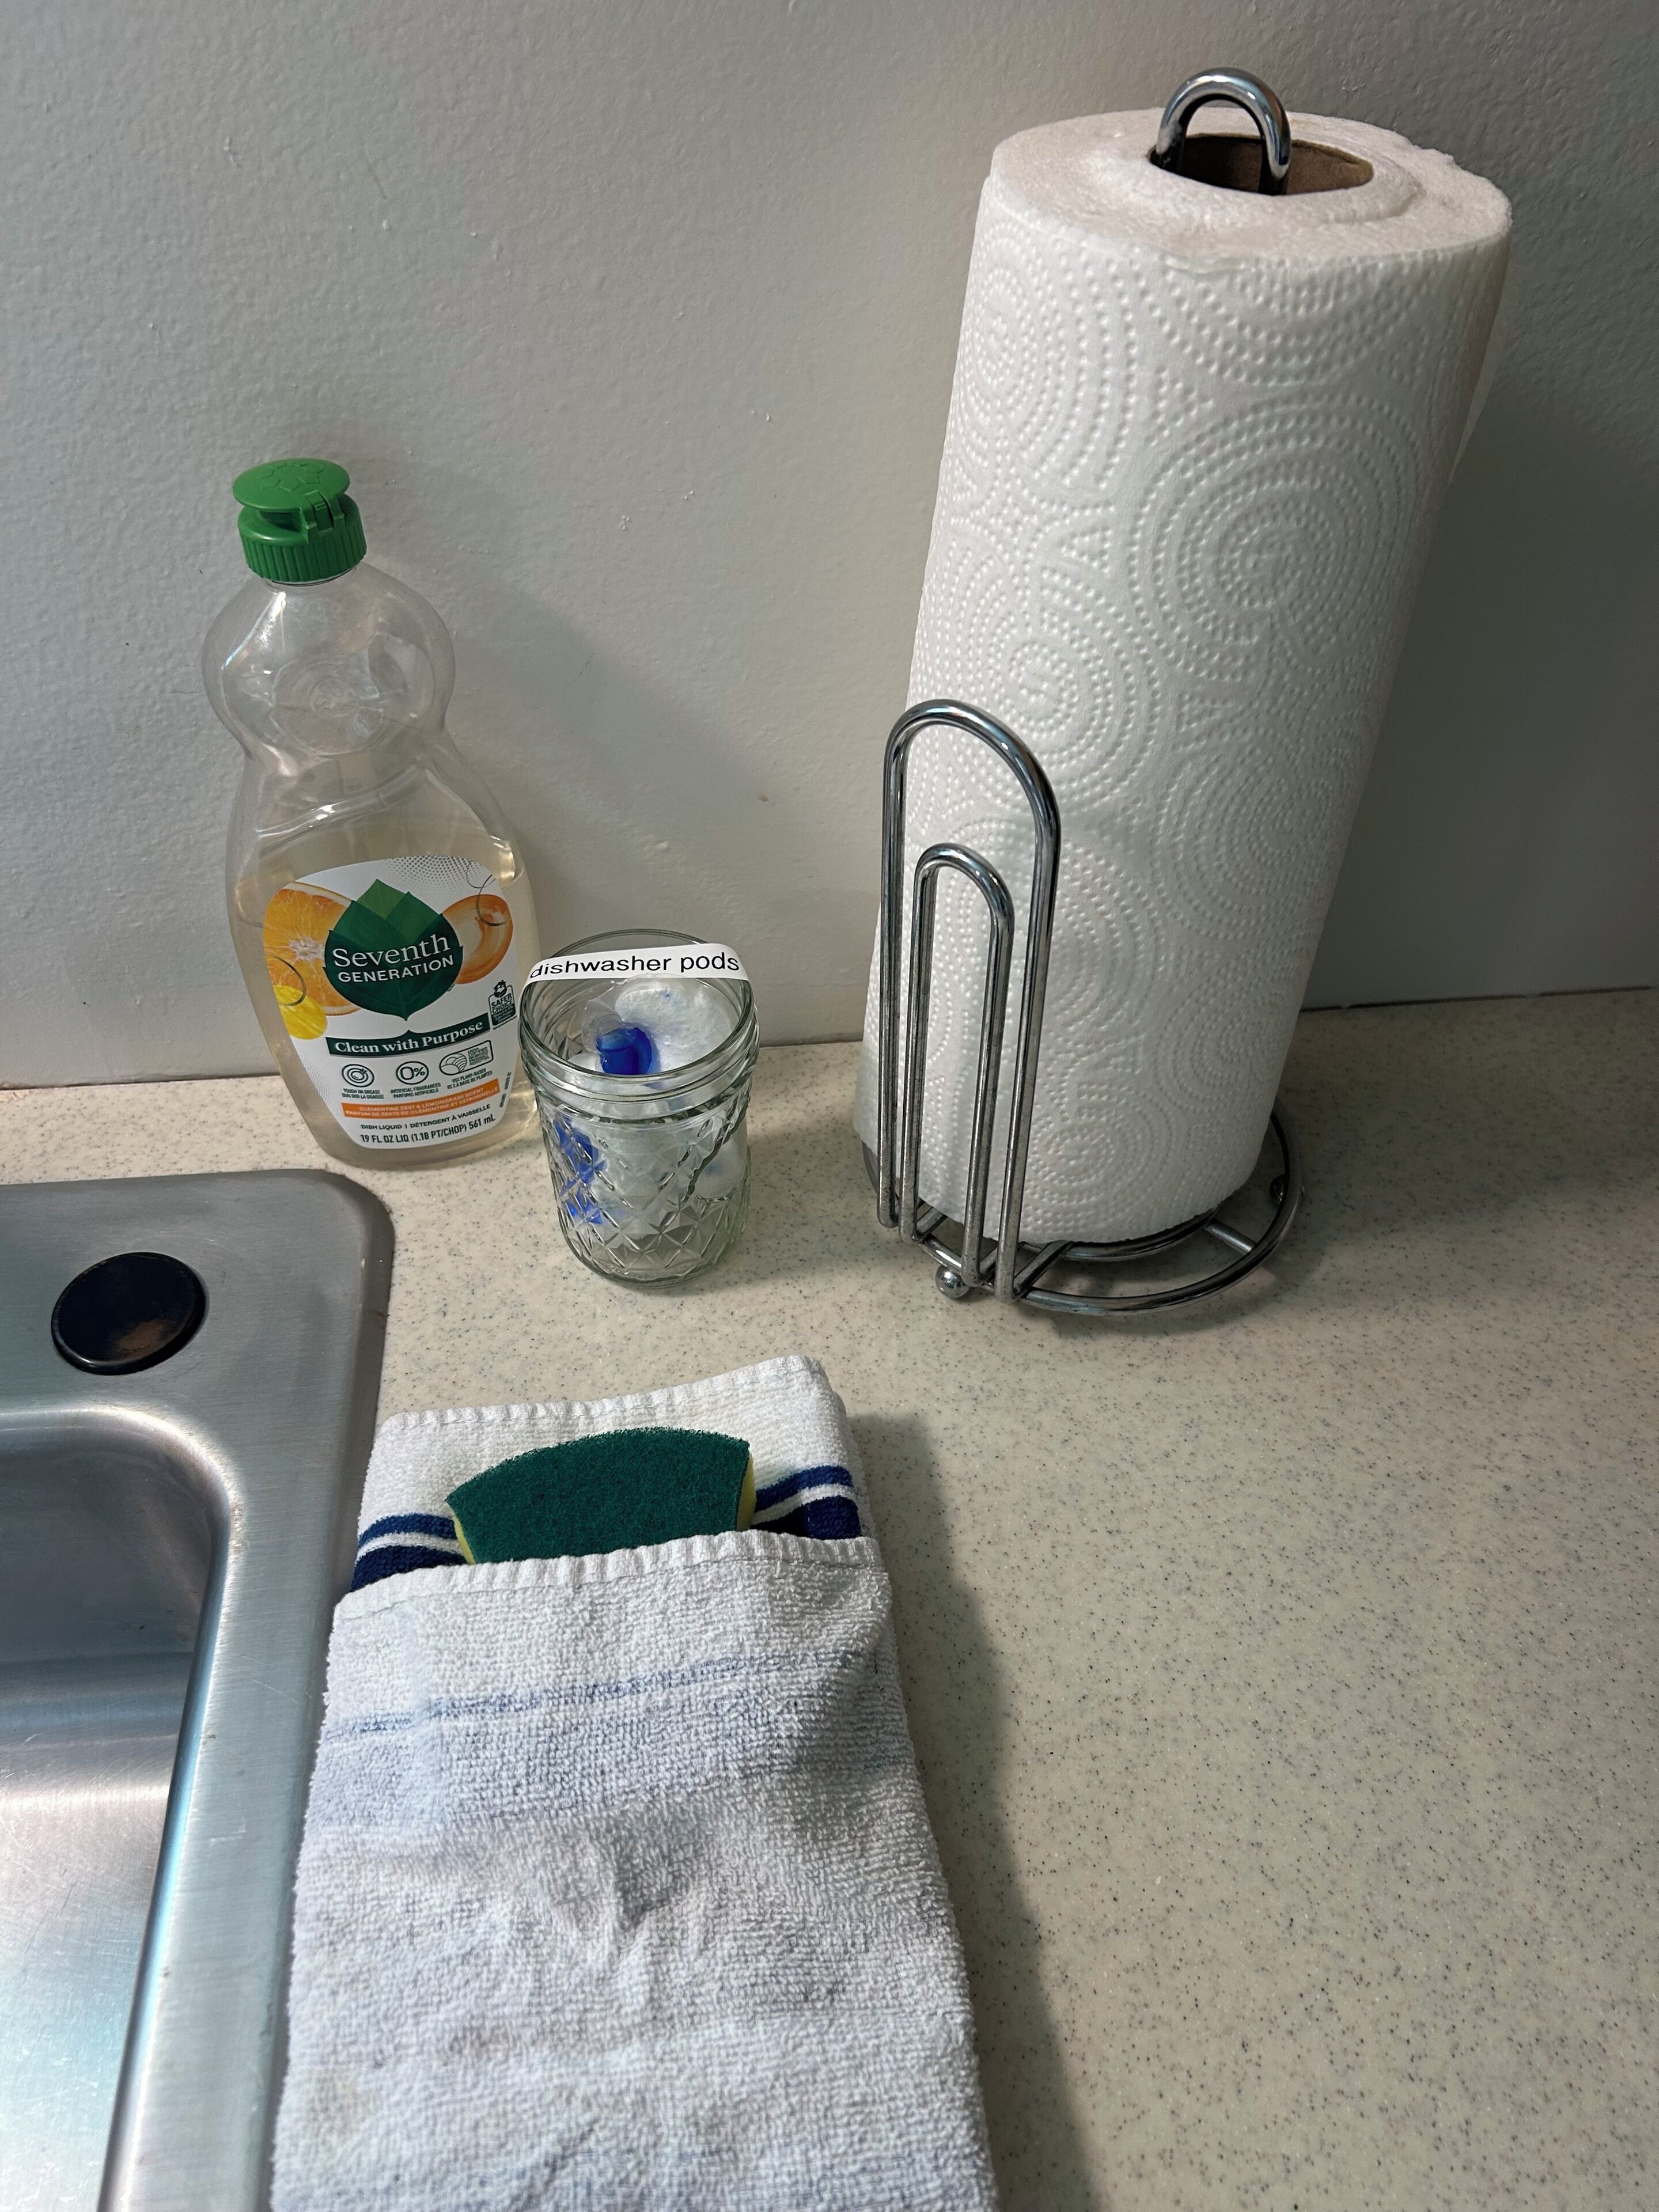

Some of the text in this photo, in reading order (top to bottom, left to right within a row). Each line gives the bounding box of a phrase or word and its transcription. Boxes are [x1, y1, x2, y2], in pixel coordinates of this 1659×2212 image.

[333, 934, 450, 967] Seventh
[338, 955, 453, 982] GENERATION
[530, 952, 740, 979] dishwasher pods
[491, 993, 512, 1009] SAFER
[492, 999, 513, 1013] CHOICE
[335, 1042, 379, 1053] Clean
[382, 1039, 419, 1052] with
[422, 1021, 483, 1047] Purpose
[400, 1066, 425, 1080] 0%
[414, 1082, 441, 1091] FRAGRANCES
[459, 1087, 498, 1105] CITRONNELLE
[422, 1095, 464, 1108] LEMONGRASS
[465, 1088, 484, 1097] SCENT
[410, 1116, 450, 1128] DÉTERGENT
[457, 1104, 491, 1119] VAISSELLE
[372, 1135, 382, 1143] FL
[383, 1135, 395, 1143] OZ
[395, 1134, 410, 1142] LIQ
[411, 1131, 429, 1142] (1.18
[431, 1124, 467, 1139] PT/CHOP)
[468, 1119, 482, 1129] 561
[484, 1113, 496, 1124] mL
